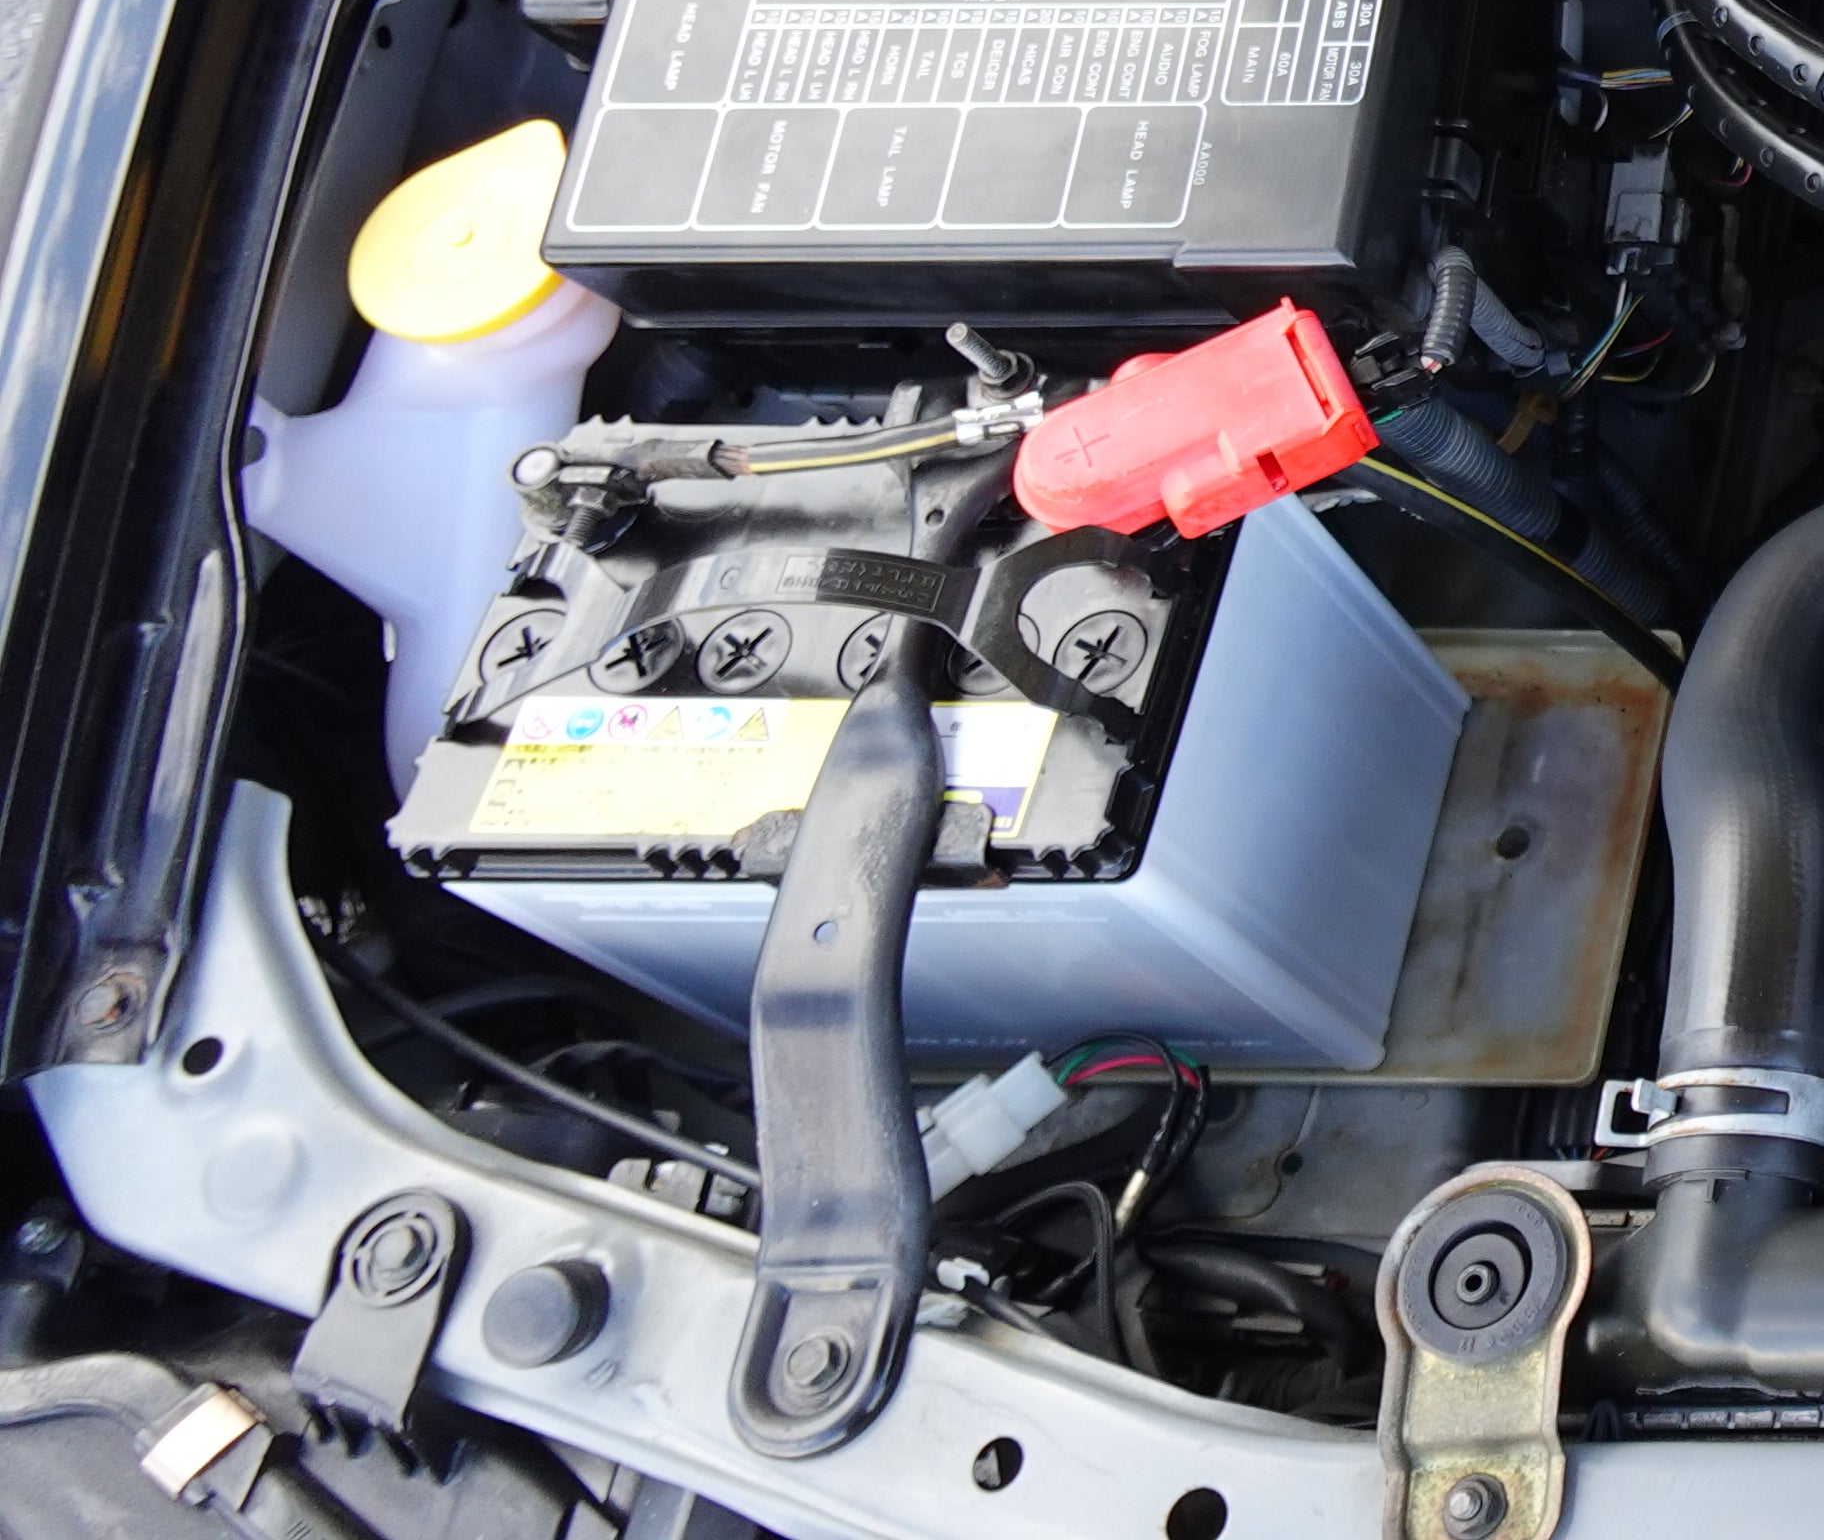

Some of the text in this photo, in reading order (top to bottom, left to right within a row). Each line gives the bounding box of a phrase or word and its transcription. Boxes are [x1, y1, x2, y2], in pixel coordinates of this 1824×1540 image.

[1332, 0, 1348, 29] ABS
[1358, 2, 1374, 28] 30A
[664, 3, 698, 91] HEAD LAMP
[747, 30, 768, 66] HEAD
[782, 30, 802, 66] HEAD
[816, 30, 837, 66] HEAD
[851, 29, 871, 65] HEAD
[880, 44, 902, 85] HORN
[916, 49, 935, 79] TAIL
[950, 51, 969, 80] TCS
[982, 38, 1006, 91] DEICER
[1017, 43, 1039, 86] HICAS
[1049, 34, 1075, 95] AIR CON
[1083, 30, 1110, 99] ENG CONT
[1118, 30, 1144, 99] ENG CONT
[1155, 43, 1174, 86] AUDIO
[1186, 30, 1212, 98] FOG LAMP
[1242, 45, 1261, 84] MAIN
[1276, 51, 1292, 77] 60A
[1318, 47, 1340, 101] MOTOR FAN
[1347, 61, 1362, 86] 30A
[750, 119, 788, 214] MOTOR FAN
[875, 125, 907, 208] TAIL LAMP
[1118, 119, 1150, 210] HEAD LAMP
[1193, 140, 1212, 186] AA000
